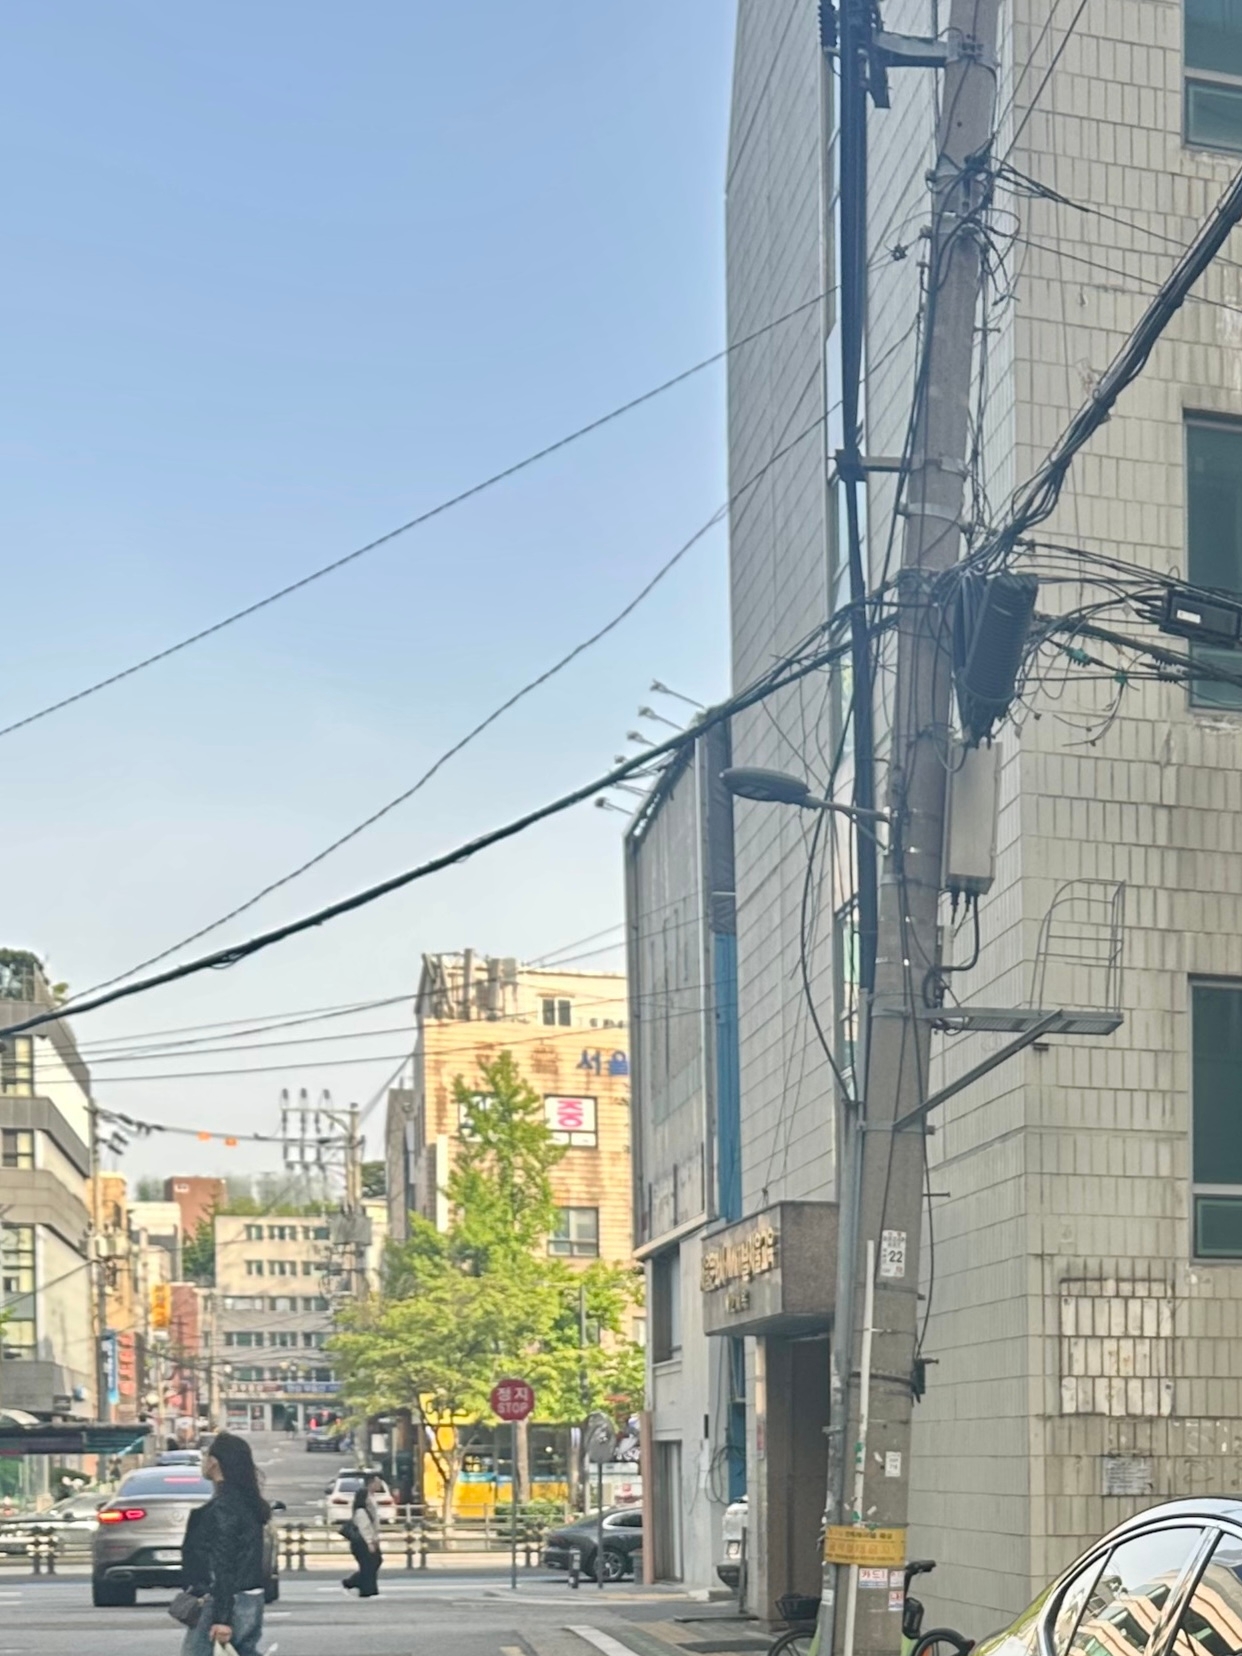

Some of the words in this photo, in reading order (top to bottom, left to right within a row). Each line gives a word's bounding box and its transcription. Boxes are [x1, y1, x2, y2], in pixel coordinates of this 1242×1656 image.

[889, 1250, 903, 1263] 22
[496, 1386, 528, 1401] 정지
[497, 1402, 528, 1414] STOP
